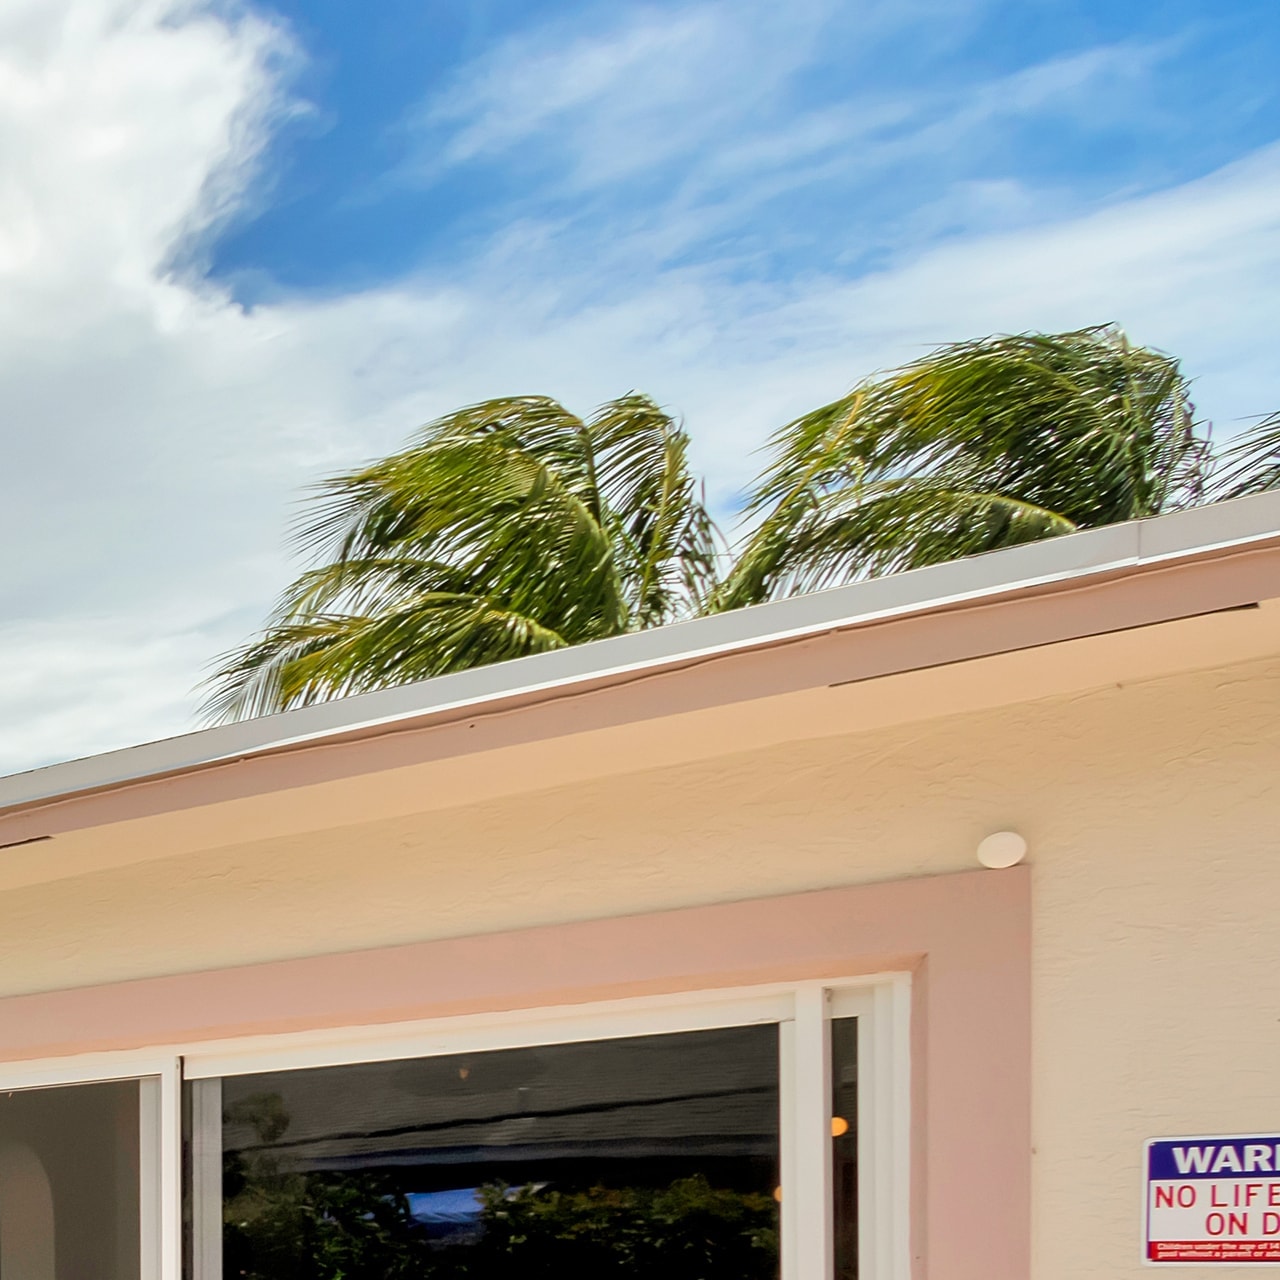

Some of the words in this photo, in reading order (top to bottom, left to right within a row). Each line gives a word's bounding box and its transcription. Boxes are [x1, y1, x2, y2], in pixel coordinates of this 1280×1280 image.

[1172, 1144, 1280, 1174] WAR
[1155, 1185, 1197, 1208] NO
[1211, 1183, 1280, 1208] LIFE
[1205, 1212, 1248, 1236] ON
[1262, 1212, 1280, 1236] D
